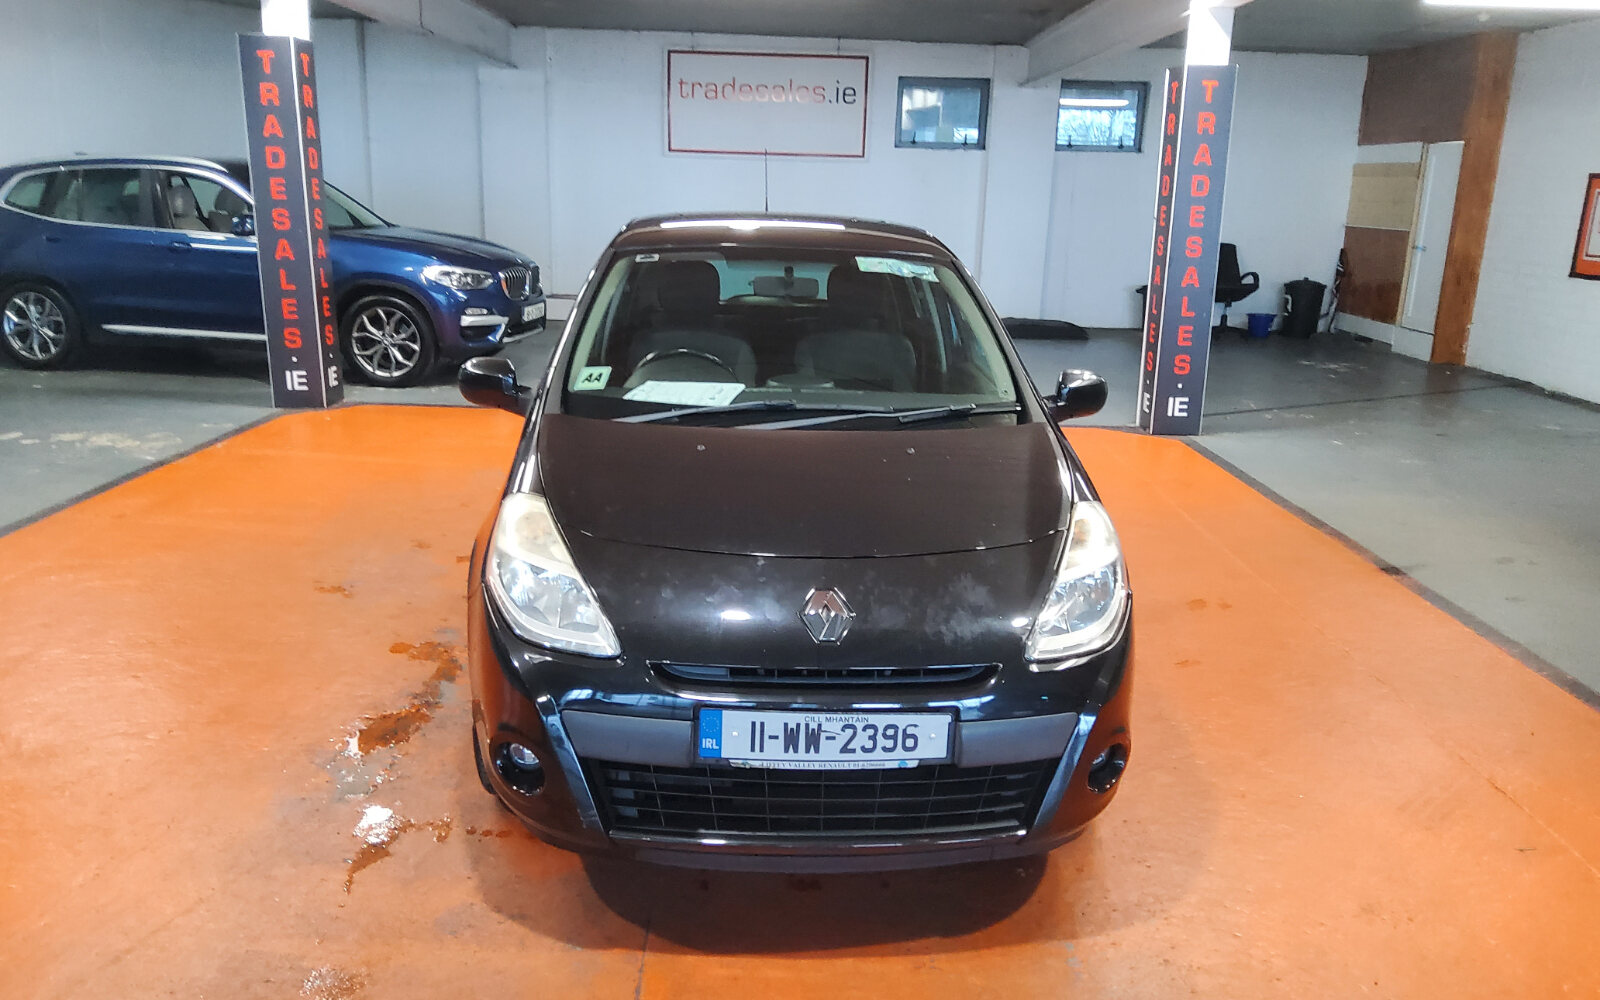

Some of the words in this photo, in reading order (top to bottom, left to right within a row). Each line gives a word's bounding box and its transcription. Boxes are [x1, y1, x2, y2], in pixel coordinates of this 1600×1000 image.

[678, 76, 857, 105] tradesales.ie
[582, 373, 603, 383] AA
[804, 715, 822, 723] CILL
[750, 721, 920, 754] 11-WW-2396
[702, 738, 719, 749] IRL
